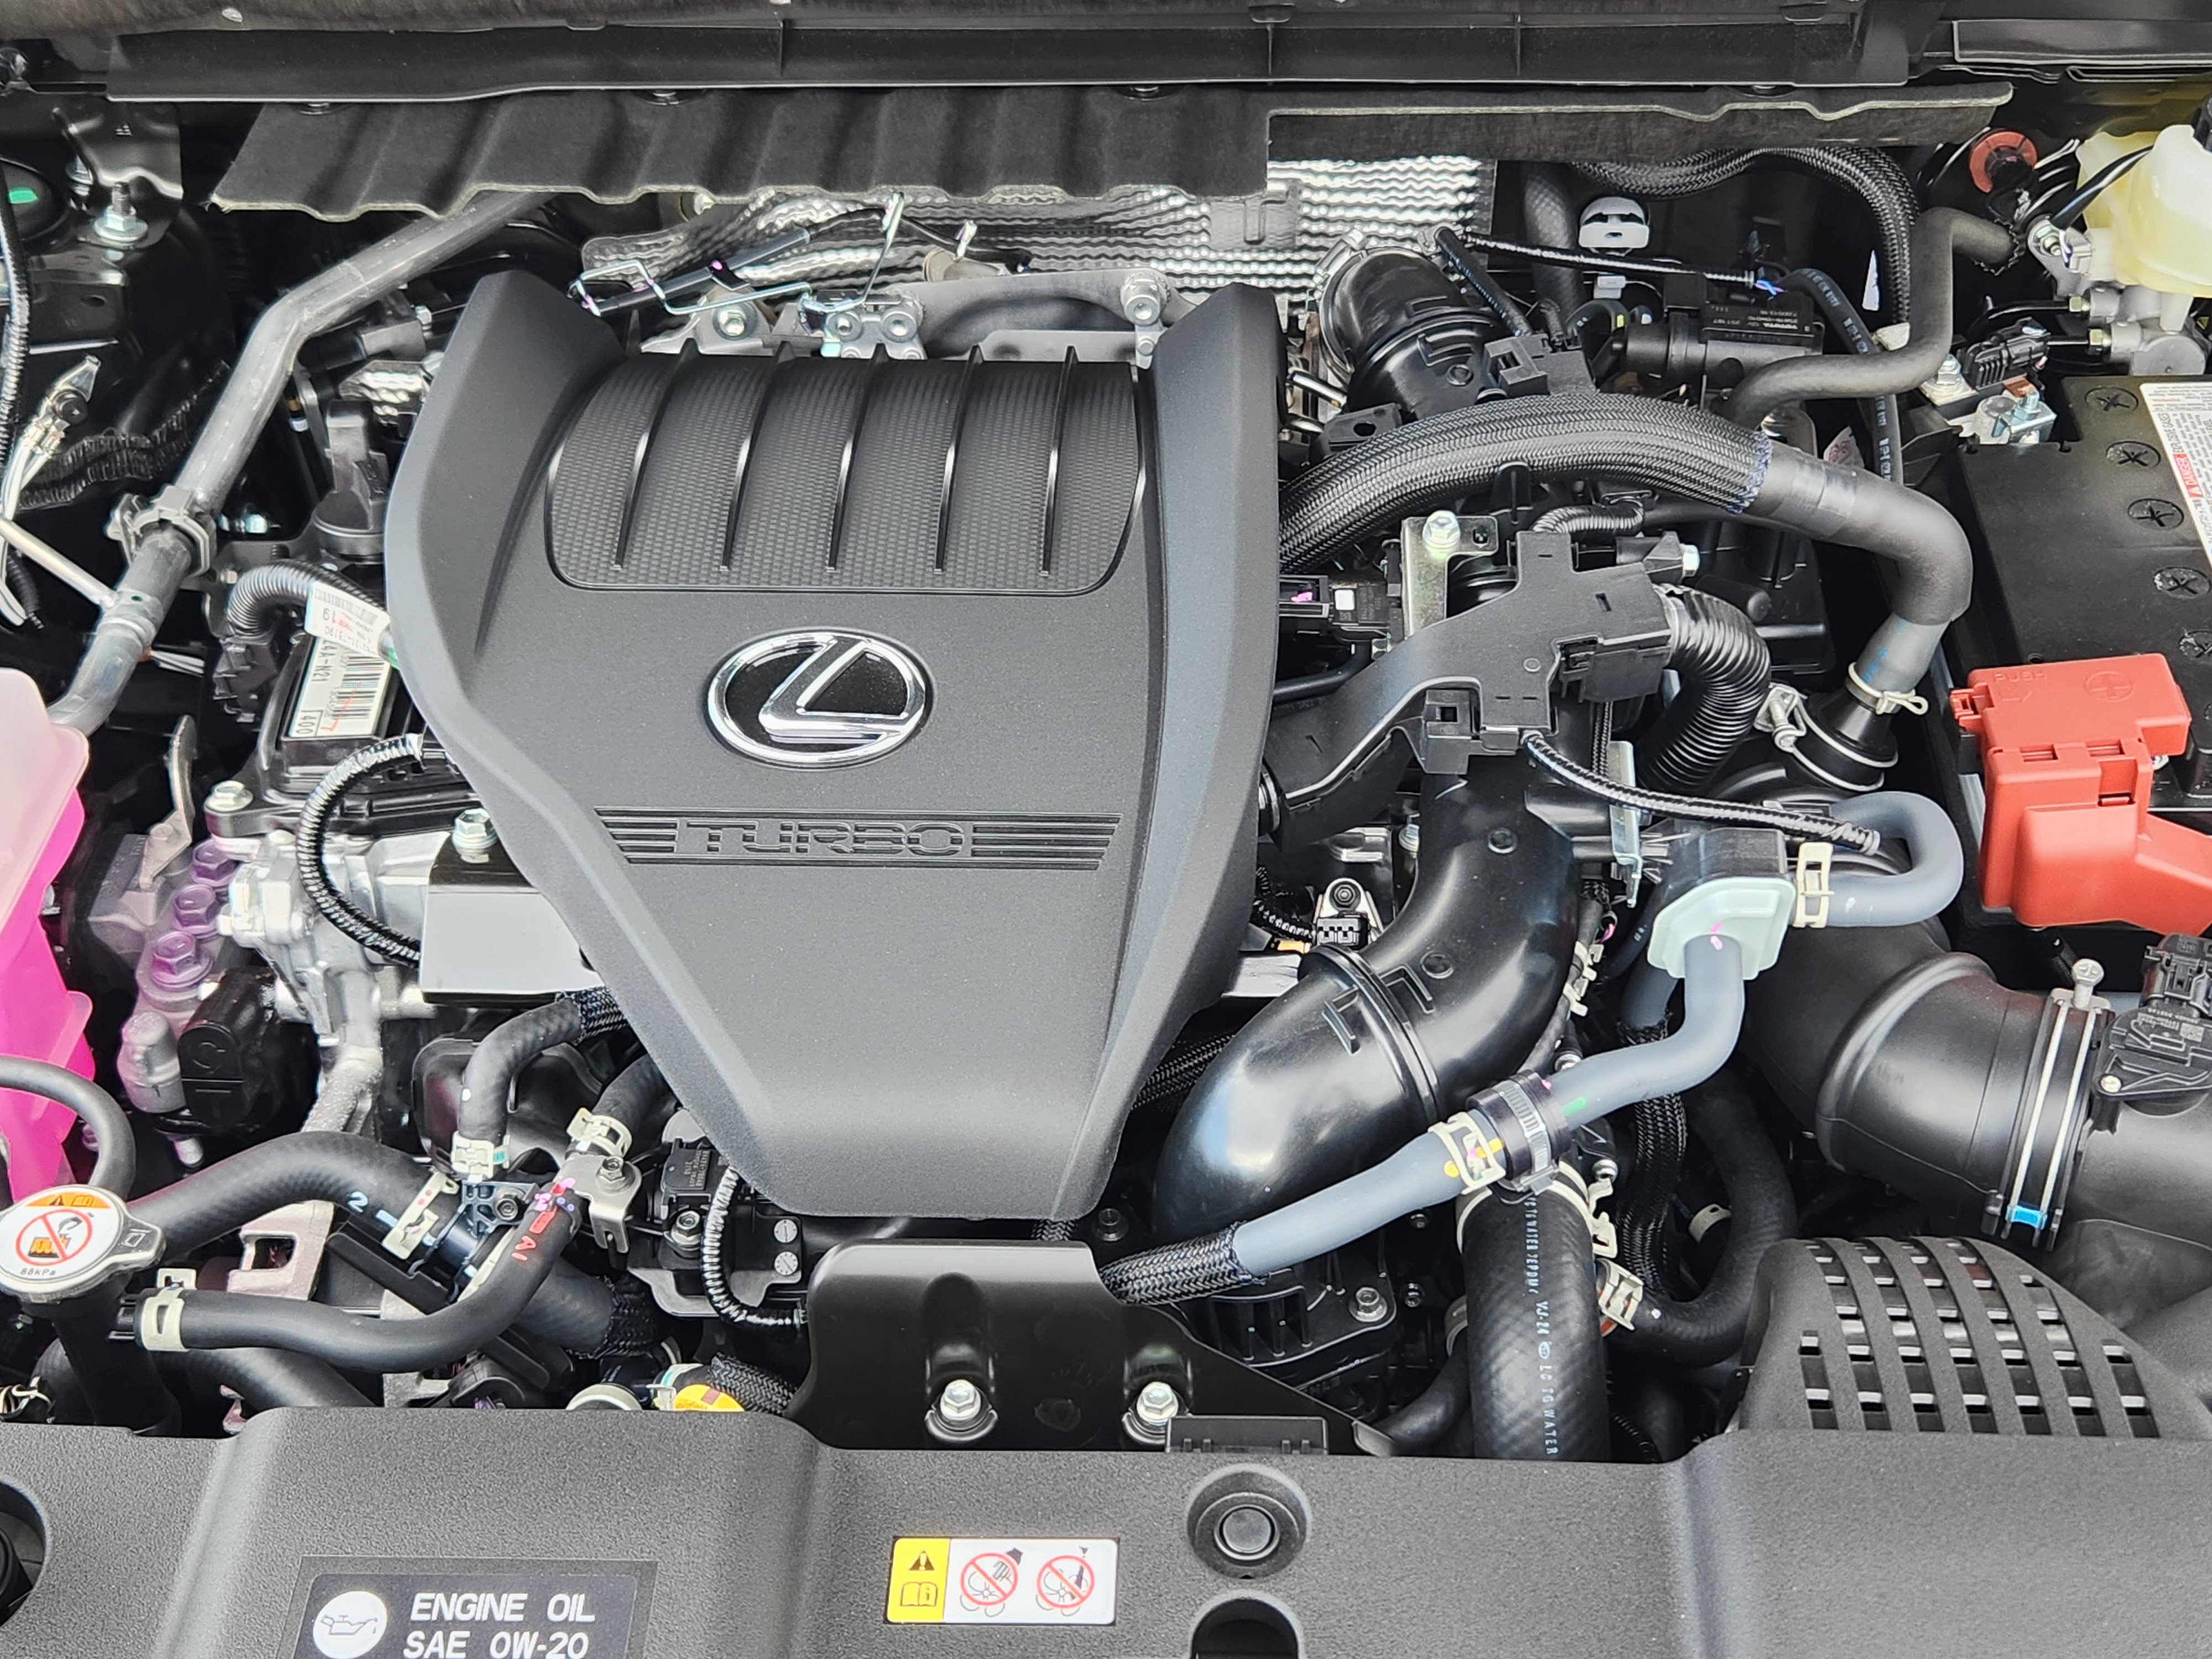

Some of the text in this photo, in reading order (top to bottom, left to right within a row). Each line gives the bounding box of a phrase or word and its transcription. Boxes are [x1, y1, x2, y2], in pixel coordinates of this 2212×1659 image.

[322, 608, 336, 623] 19
[295, 716, 317, 734] 400
[686, 819, 966, 857] TURBO
[1543, 1408, 1559, 1454] WATER
[410, 1593, 596, 1622] ENGINE OIL
[403, 1631, 589, 1659] SAE 0W-20
